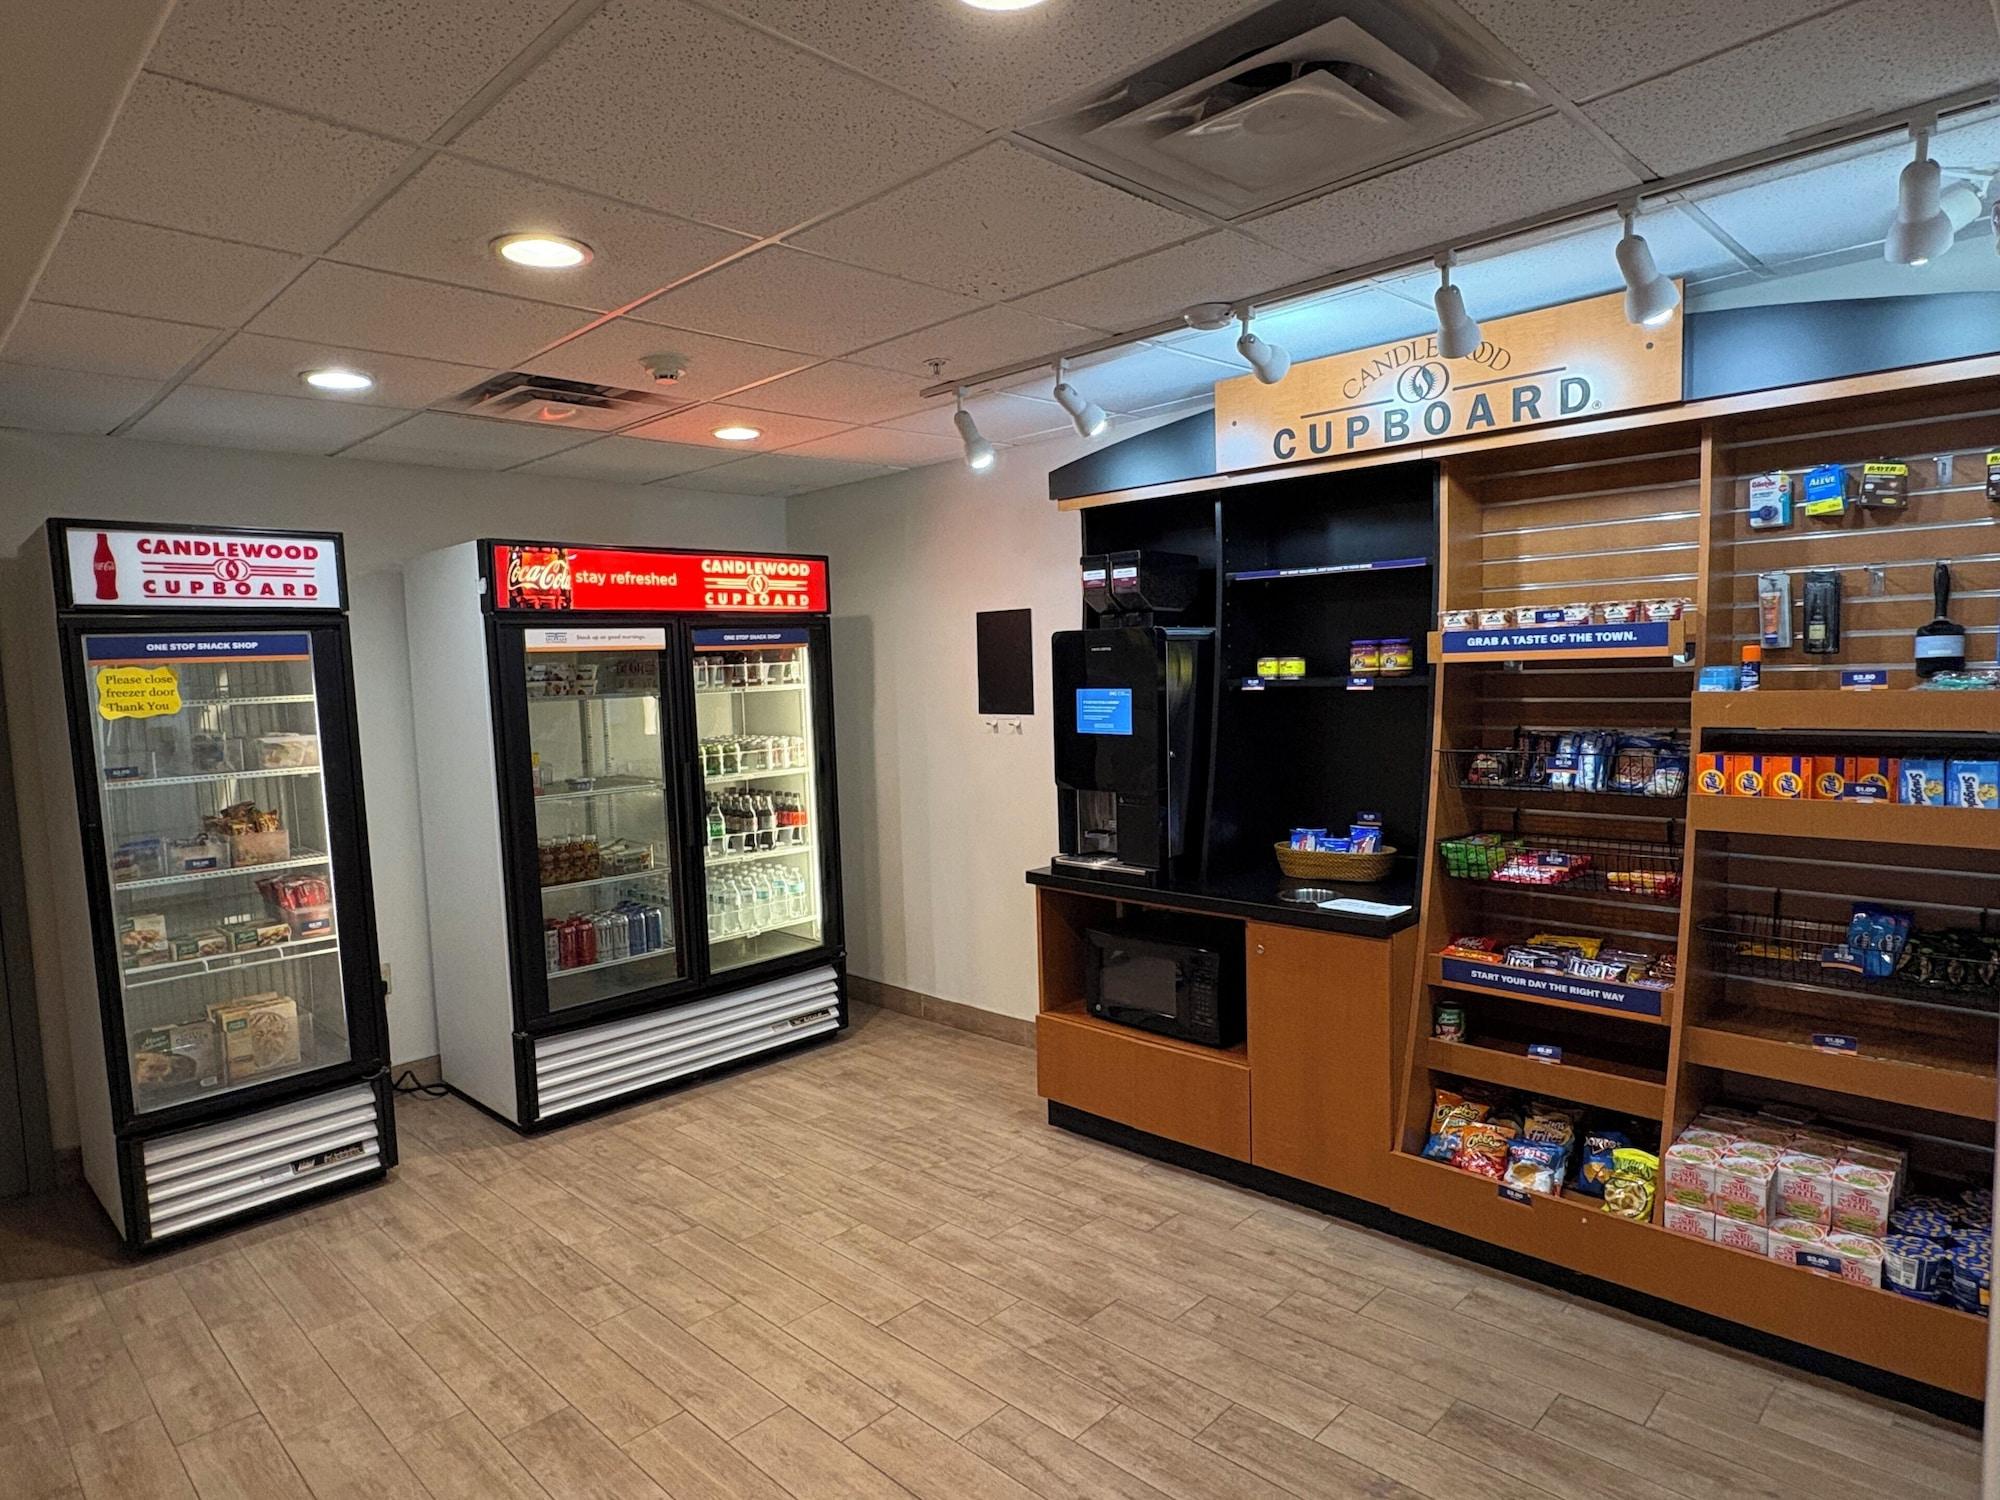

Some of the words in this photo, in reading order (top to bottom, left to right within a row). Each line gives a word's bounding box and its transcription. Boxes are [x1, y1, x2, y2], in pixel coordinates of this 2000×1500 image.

[1342, 338, 1511, 399] CANDLEOD
[1273, 377, 1591, 460] CUPBOARD
[137, 539, 318, 560] CANDLEWOOD
[701, 559, 810, 576] CANDLEWOOD
[575, 571, 606, 586] stay
[611, 571, 678, 586] refreshed
[143, 580, 318, 596] CUPBOARD
[704, 592, 809, 606] CUPBOARD
[146, 643, 168, 651] ONE
[170, 642, 196, 651] STOP
[197, 642, 231, 650] SNACK
[231, 641, 258, 650] SHOP
[1467, 636, 1499, 647] GRAB
[1501, 636, 1510, 646] A
[1511, 635, 1548, 645] TASTE
[1550, 634, 1566, 644] OF
[1569, 633, 1594, 643] THE
[1596, 631, 1637, 642] TOWN.
[105, 675, 142, 684] Please
[144, 674, 173, 684] close
[106, 688, 146, 698] freezer
[148, 687, 175, 697] door
[107, 702, 144, 712] Thank
[147, 701, 169, 711] You
[1780, 773, 1797, 793] Tide
[1471, 970, 1499, 982] START
[1501, 974, 1526, 987] YOUR
[1528, 978, 1548, 990] DAY
[1548, 982, 1568, 993] THE
[1569, 986, 1601, 998] RIGHT
[1602, 990, 1625, 1002] WAY
